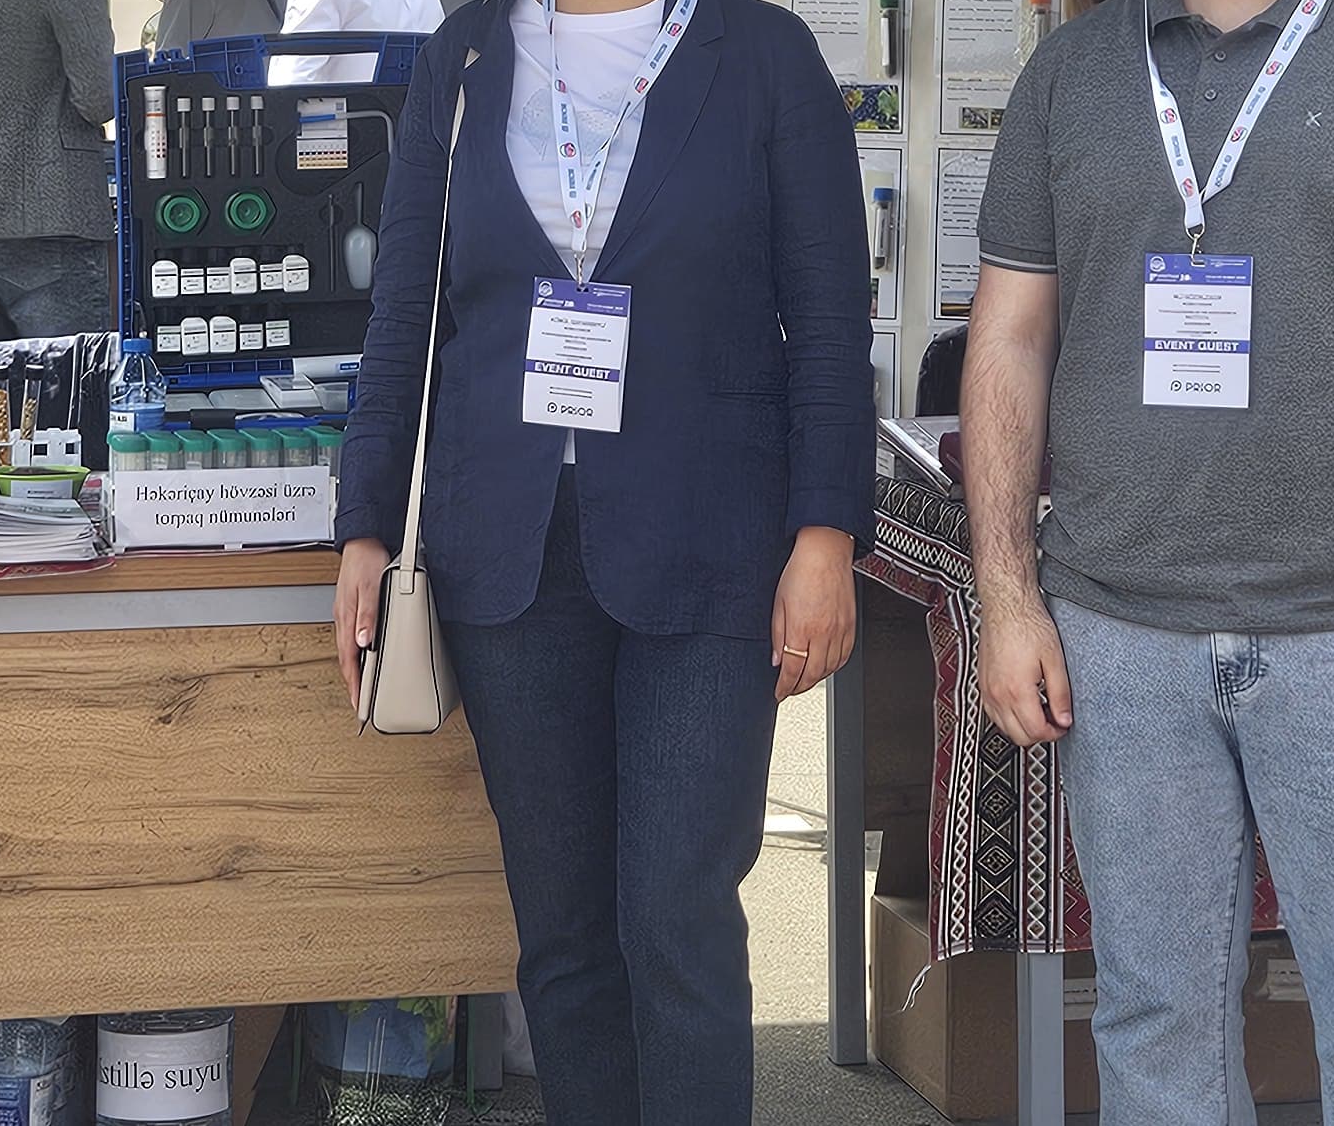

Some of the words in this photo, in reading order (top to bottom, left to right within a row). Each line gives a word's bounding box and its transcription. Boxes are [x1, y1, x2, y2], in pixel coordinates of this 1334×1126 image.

[220, 483, 278, 500] hövzəsi
[155, 511, 204, 529] torpaq
[209, 505, 296, 525] nümunələri
[164, 1062, 221, 1093] suyu
